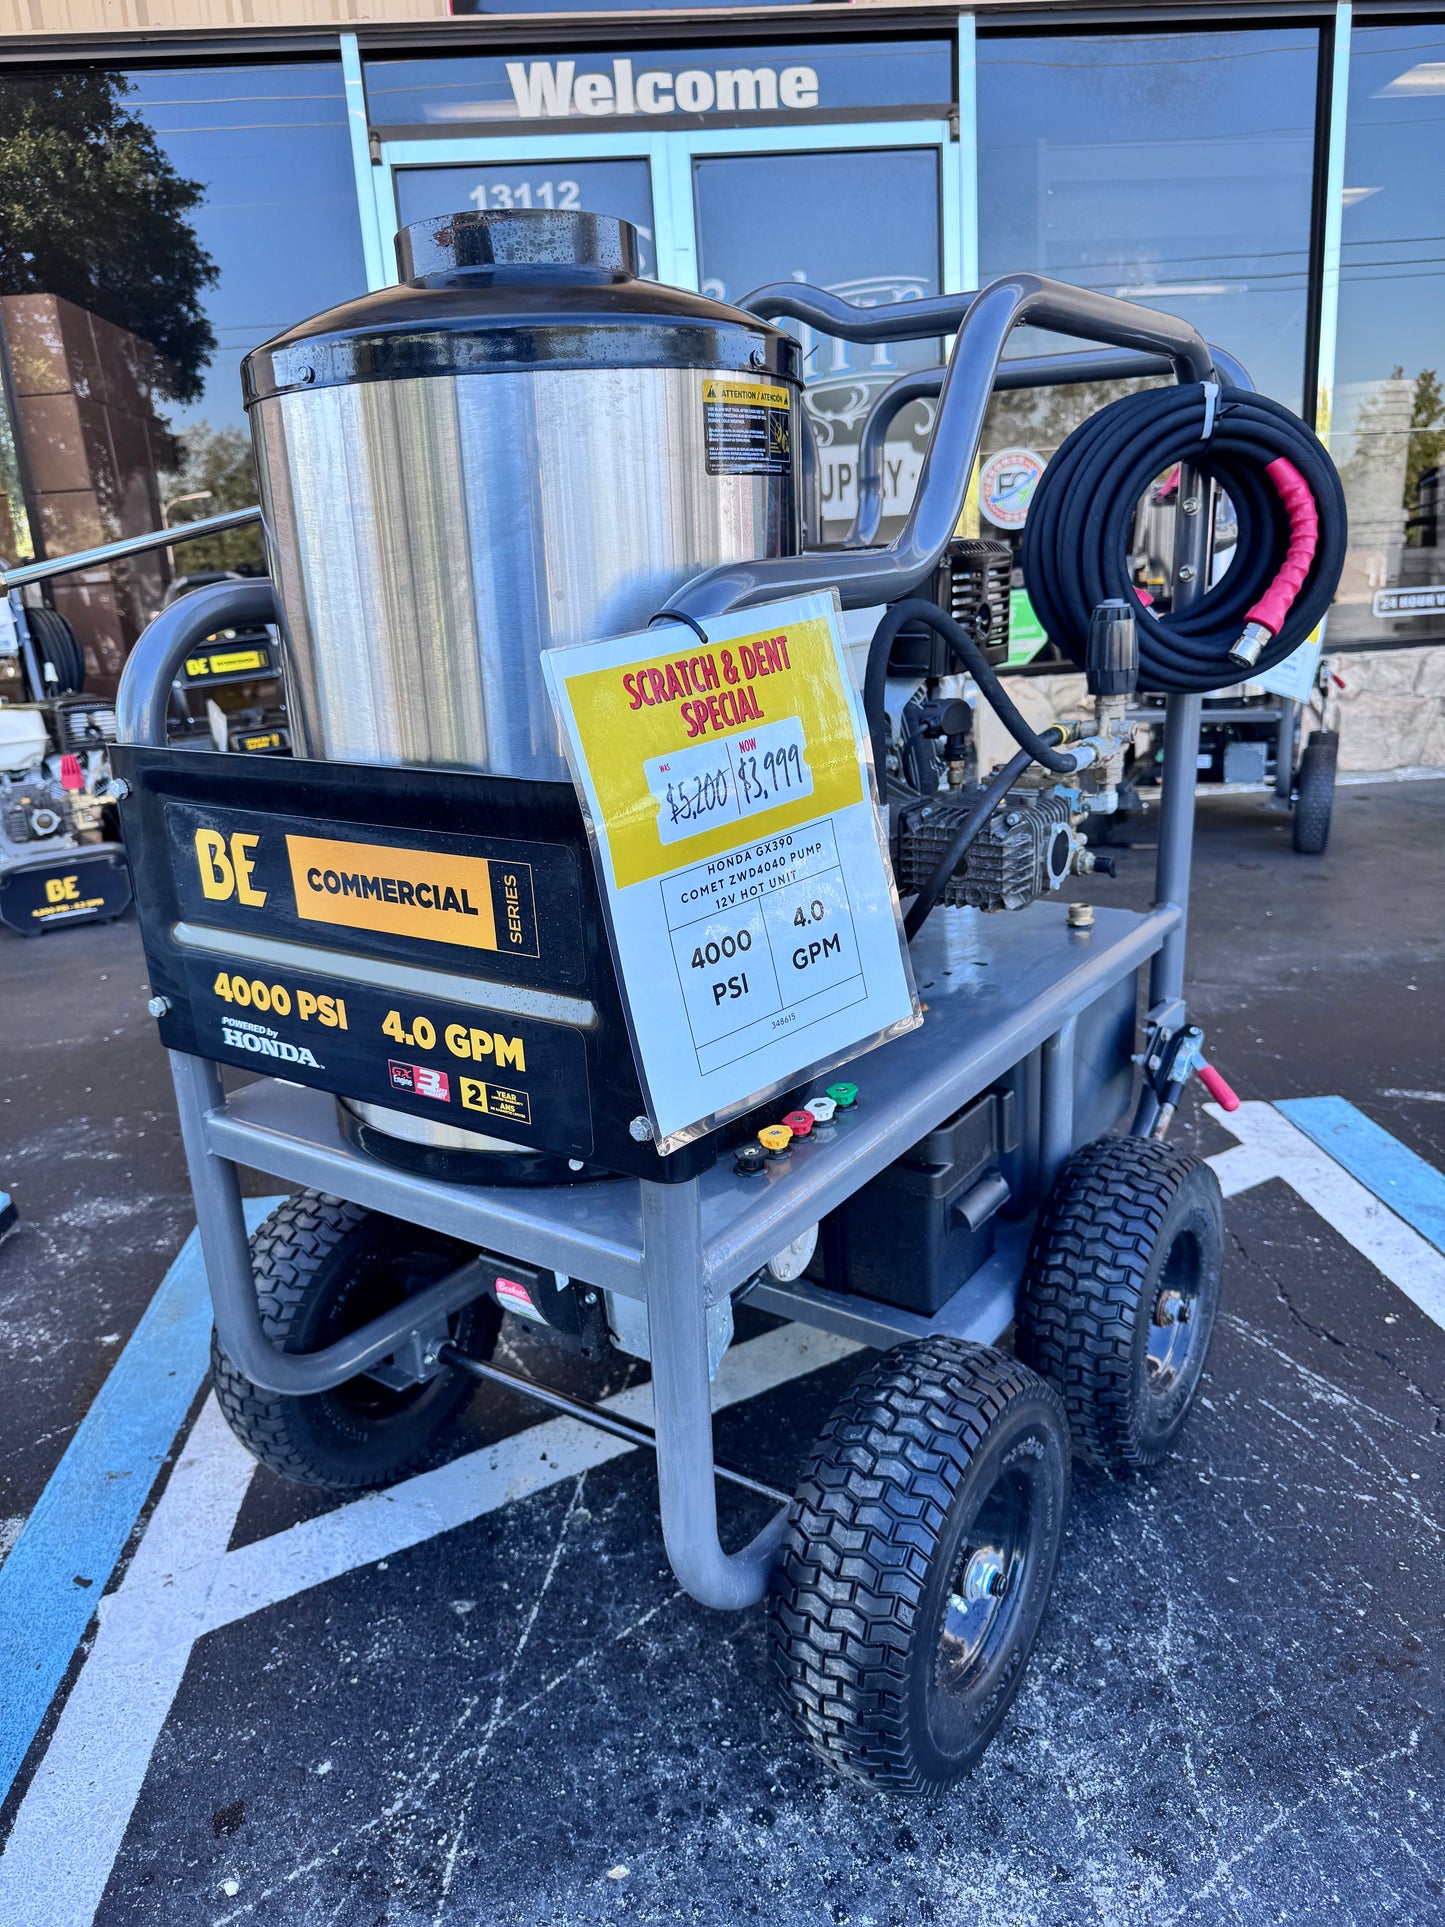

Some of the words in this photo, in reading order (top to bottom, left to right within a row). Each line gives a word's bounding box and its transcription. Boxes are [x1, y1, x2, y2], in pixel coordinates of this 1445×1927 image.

[506, 58, 819, 119] Welcome
[468, 181, 582, 210] 13112
[721, 389, 756, 400] ATTENTION
[760, 393, 783, 403] ATENCIÓN
[1381, 596, 1398, 610] 24
[1398, 593, 1436, 608] HOUR
[185, 658, 210, 676] BE
[622, 652, 721, 711] SCRATCH
[721, 649, 741, 686] &
[740, 635, 791, 679] DENT
[680, 685, 765, 738] SPECIAL
[738, 737, 757, 754] NOW
[659, 763, 671, 773] WAS
[738, 743, 803, 805] $3,999
[194, 828, 268, 909] BE
[706, 850, 752, 876] HONDA
[755, 835, 794, 858] GX390
[680, 878, 726, 904] COMET
[729, 856, 787, 887] ZWD4040
[789, 842, 823, 864] PUMP
[45, 875, 81, 903] BE
[306, 866, 480, 917] COMMERCIAL
[715, 894, 737, 910] 12V
[740, 882, 765, 901] HOT
[768, 870, 798, 889] UNIT
[507, 873, 523, 944] SERIES
[792, 899, 825, 929] 4.0
[691, 928, 753, 970] 4000
[791, 932, 842, 971] GPM
[711, 972, 750, 1006] PSI
[213, 971, 292, 1017] 4000
[296, 989, 349, 1031] PSI
[381, 1010, 437, 1051] 4.0
[444, 1024, 527, 1073] GPM
[221, 1016, 267, 1035] POWERED
[266, 1027, 279, 1039] by
[770, 1012, 797, 1030] 348615
[221, 1027, 321, 1069] HONDA
[391, 1066, 413, 1080] GX
[393, 1075, 413, 1087] Engine
[417, 1068, 441, 1092] 3
[467, 1084, 483, 1107] 2
[495, 1090, 517, 1102] YEAR
[499, 1102, 516, 1113] ANS
